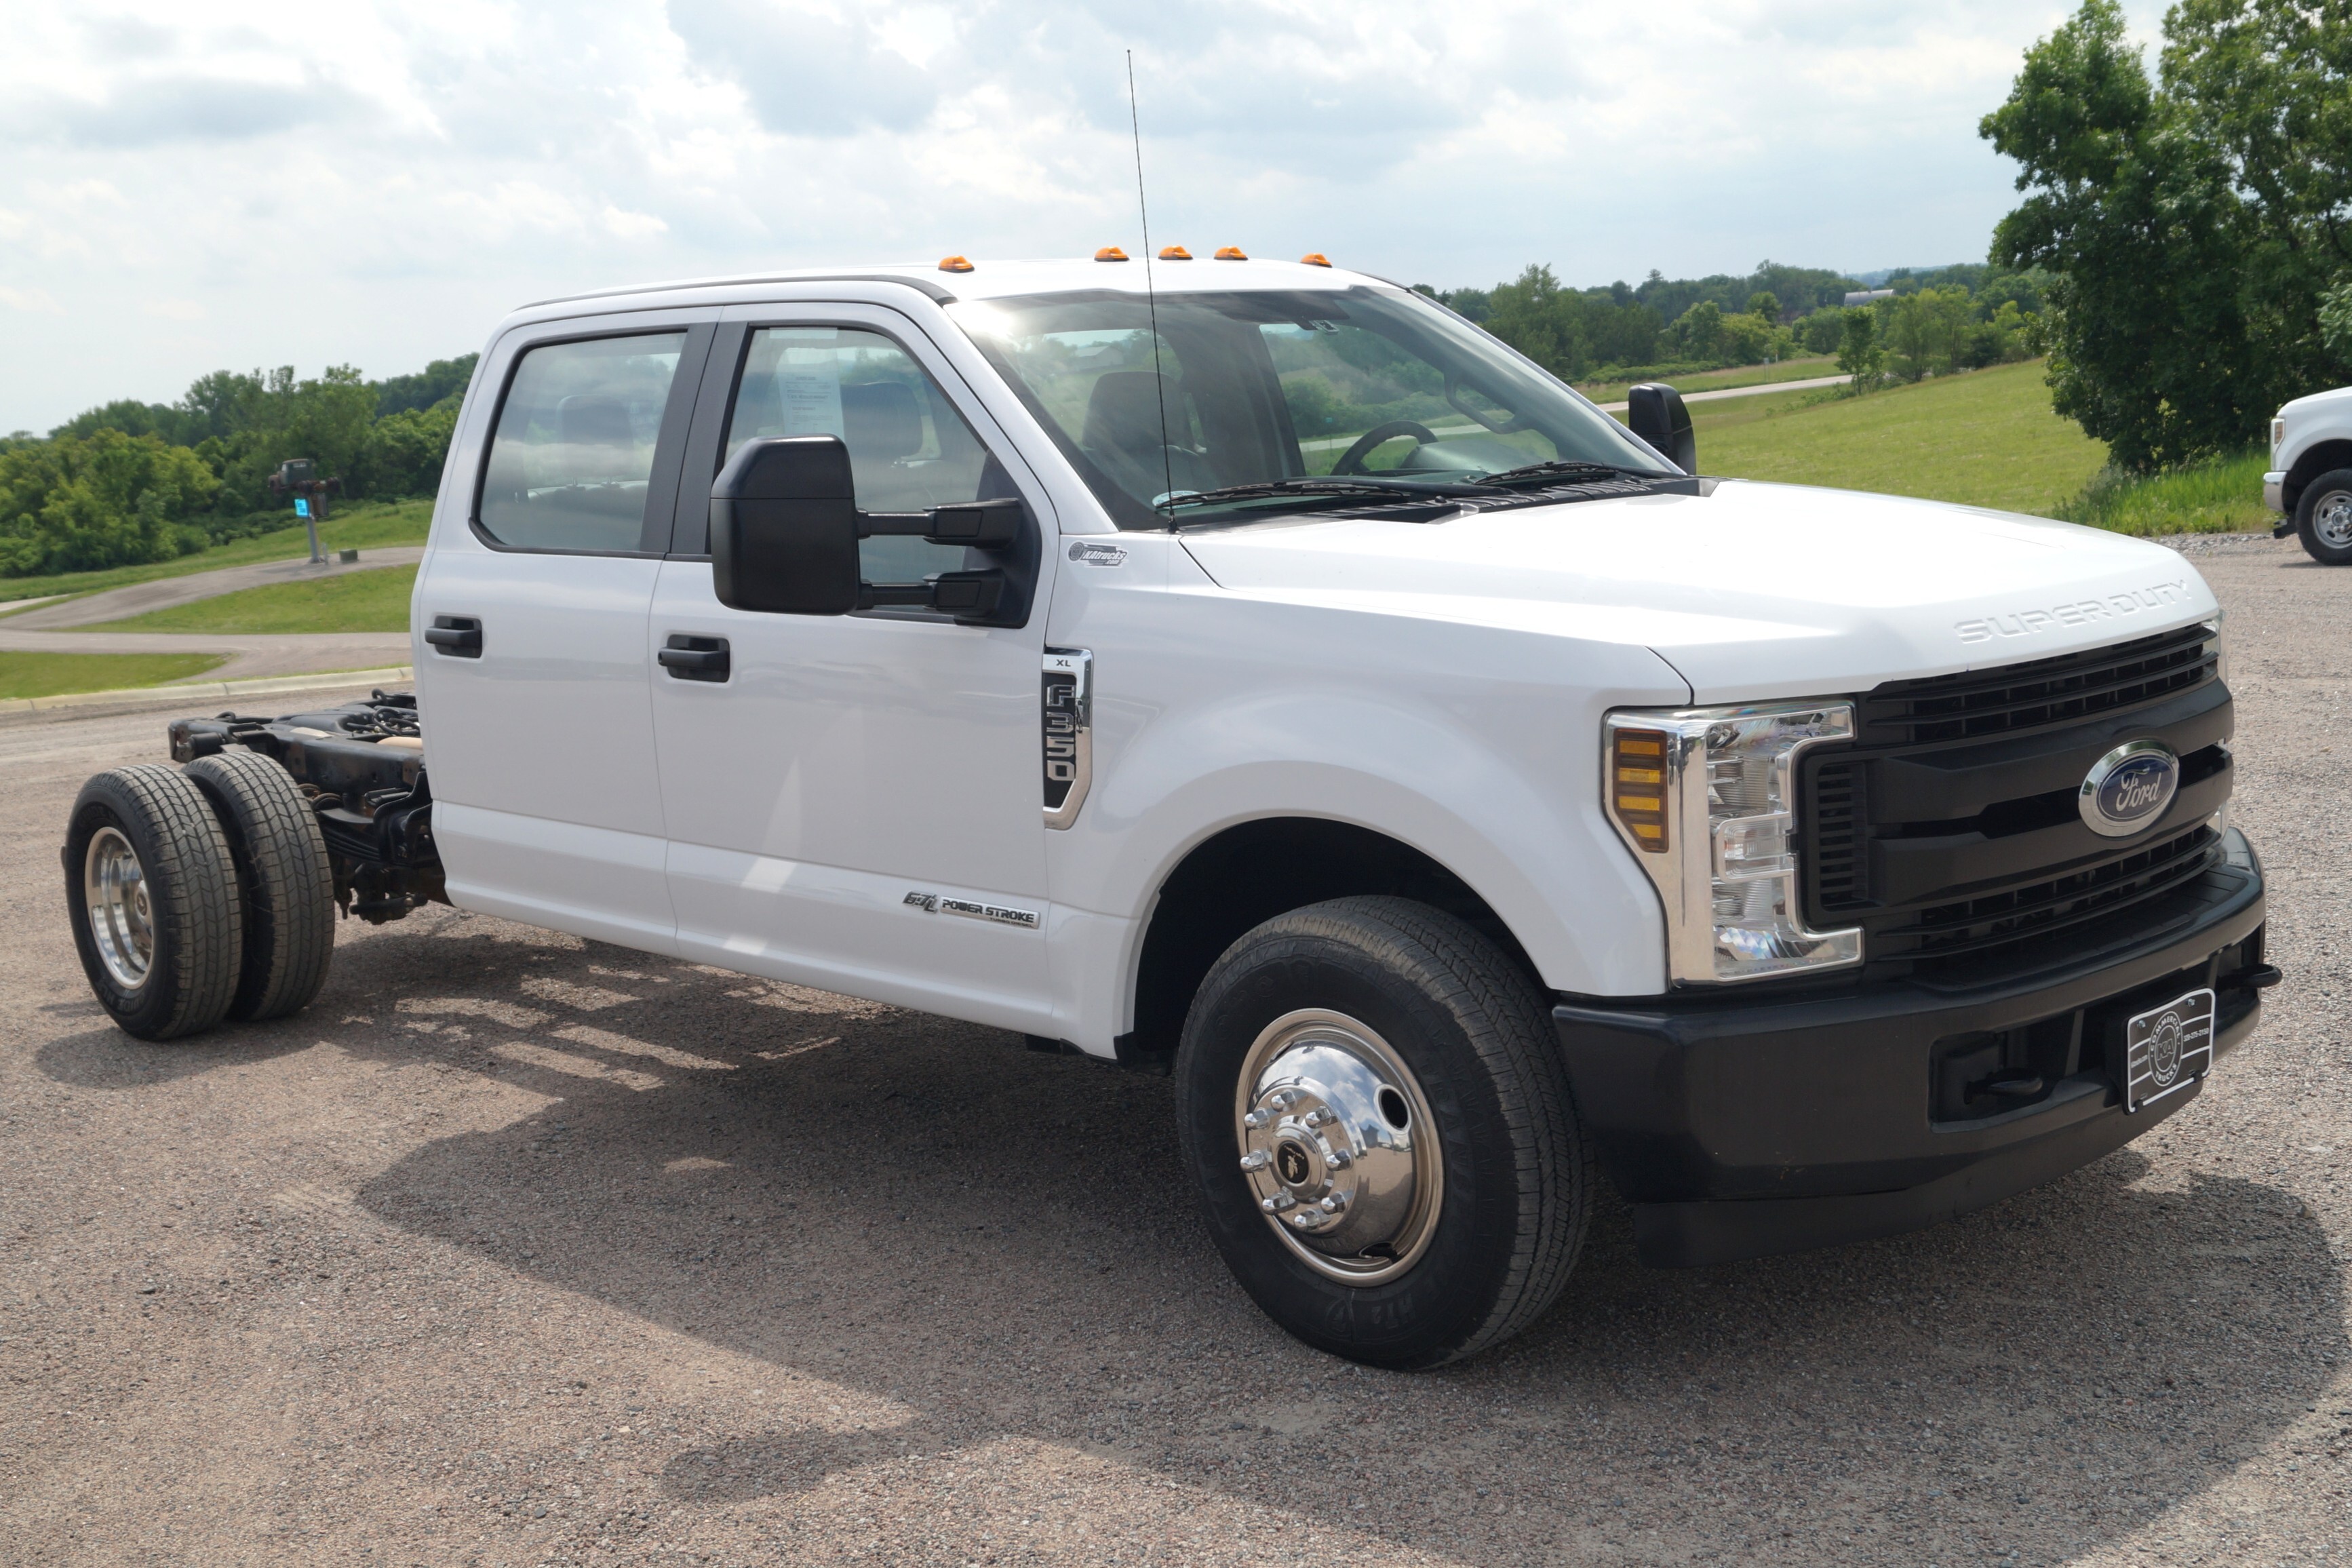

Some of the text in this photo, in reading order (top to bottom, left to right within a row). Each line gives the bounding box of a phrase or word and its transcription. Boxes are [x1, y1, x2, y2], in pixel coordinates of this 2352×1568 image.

[1953, 579, 2192, 644] SUPER DUTY
[1056, 659, 1072, 667] XL
[2115, 765, 2161, 812] Ford
[902, 891, 938, 914] 6.7L
[942, 899, 1035, 923] POWER STROKE
[1011, 920, 1034, 928] DIESEL
[2150, 1015, 2180, 1051] COMMERCIAL
[2156, 1038, 2175, 1061] KA
[2155, 1063, 2177, 1082] TRUCKS
